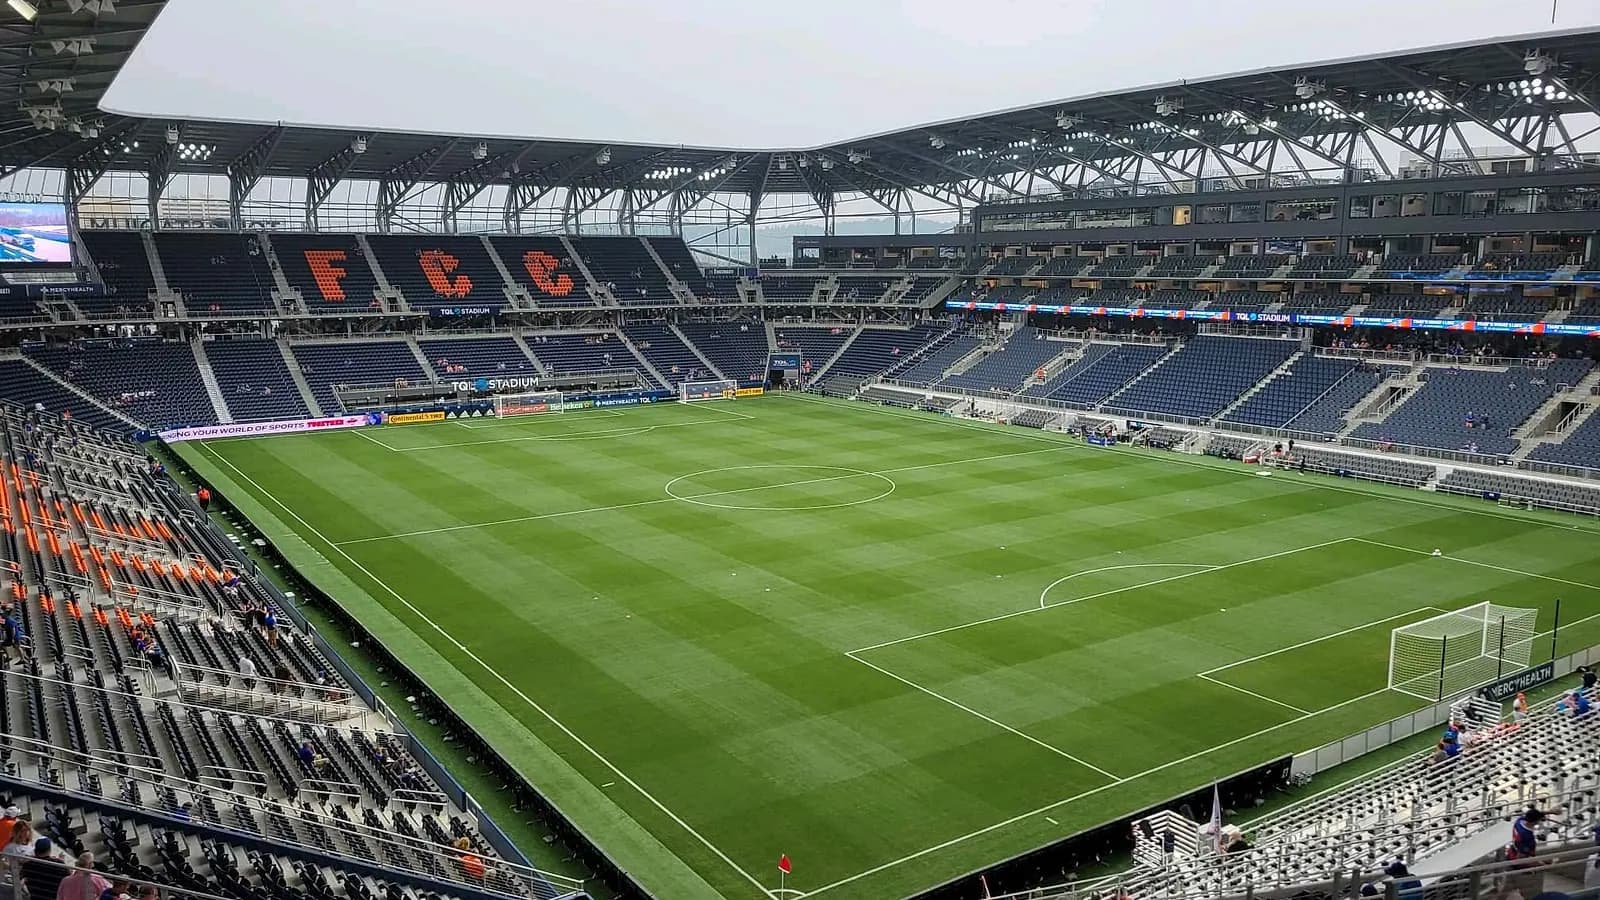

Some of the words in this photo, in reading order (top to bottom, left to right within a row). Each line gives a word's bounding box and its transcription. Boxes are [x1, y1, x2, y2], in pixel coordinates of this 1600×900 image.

[440, 308, 454, 316] TQL
[461, 307, 490, 315] STADIUM
[1236, 312, 1250, 321] TQL
[1257, 313, 1290, 322] STADIUM
[451, 381, 476, 392] TQL
[488, 377, 539, 389] STADIUM
[193, 428, 218, 437] YOUR
[219, 425, 254, 435] WORLD
[254, 424, 268, 432] OF
[268, 422, 304, 431] SPORTS
